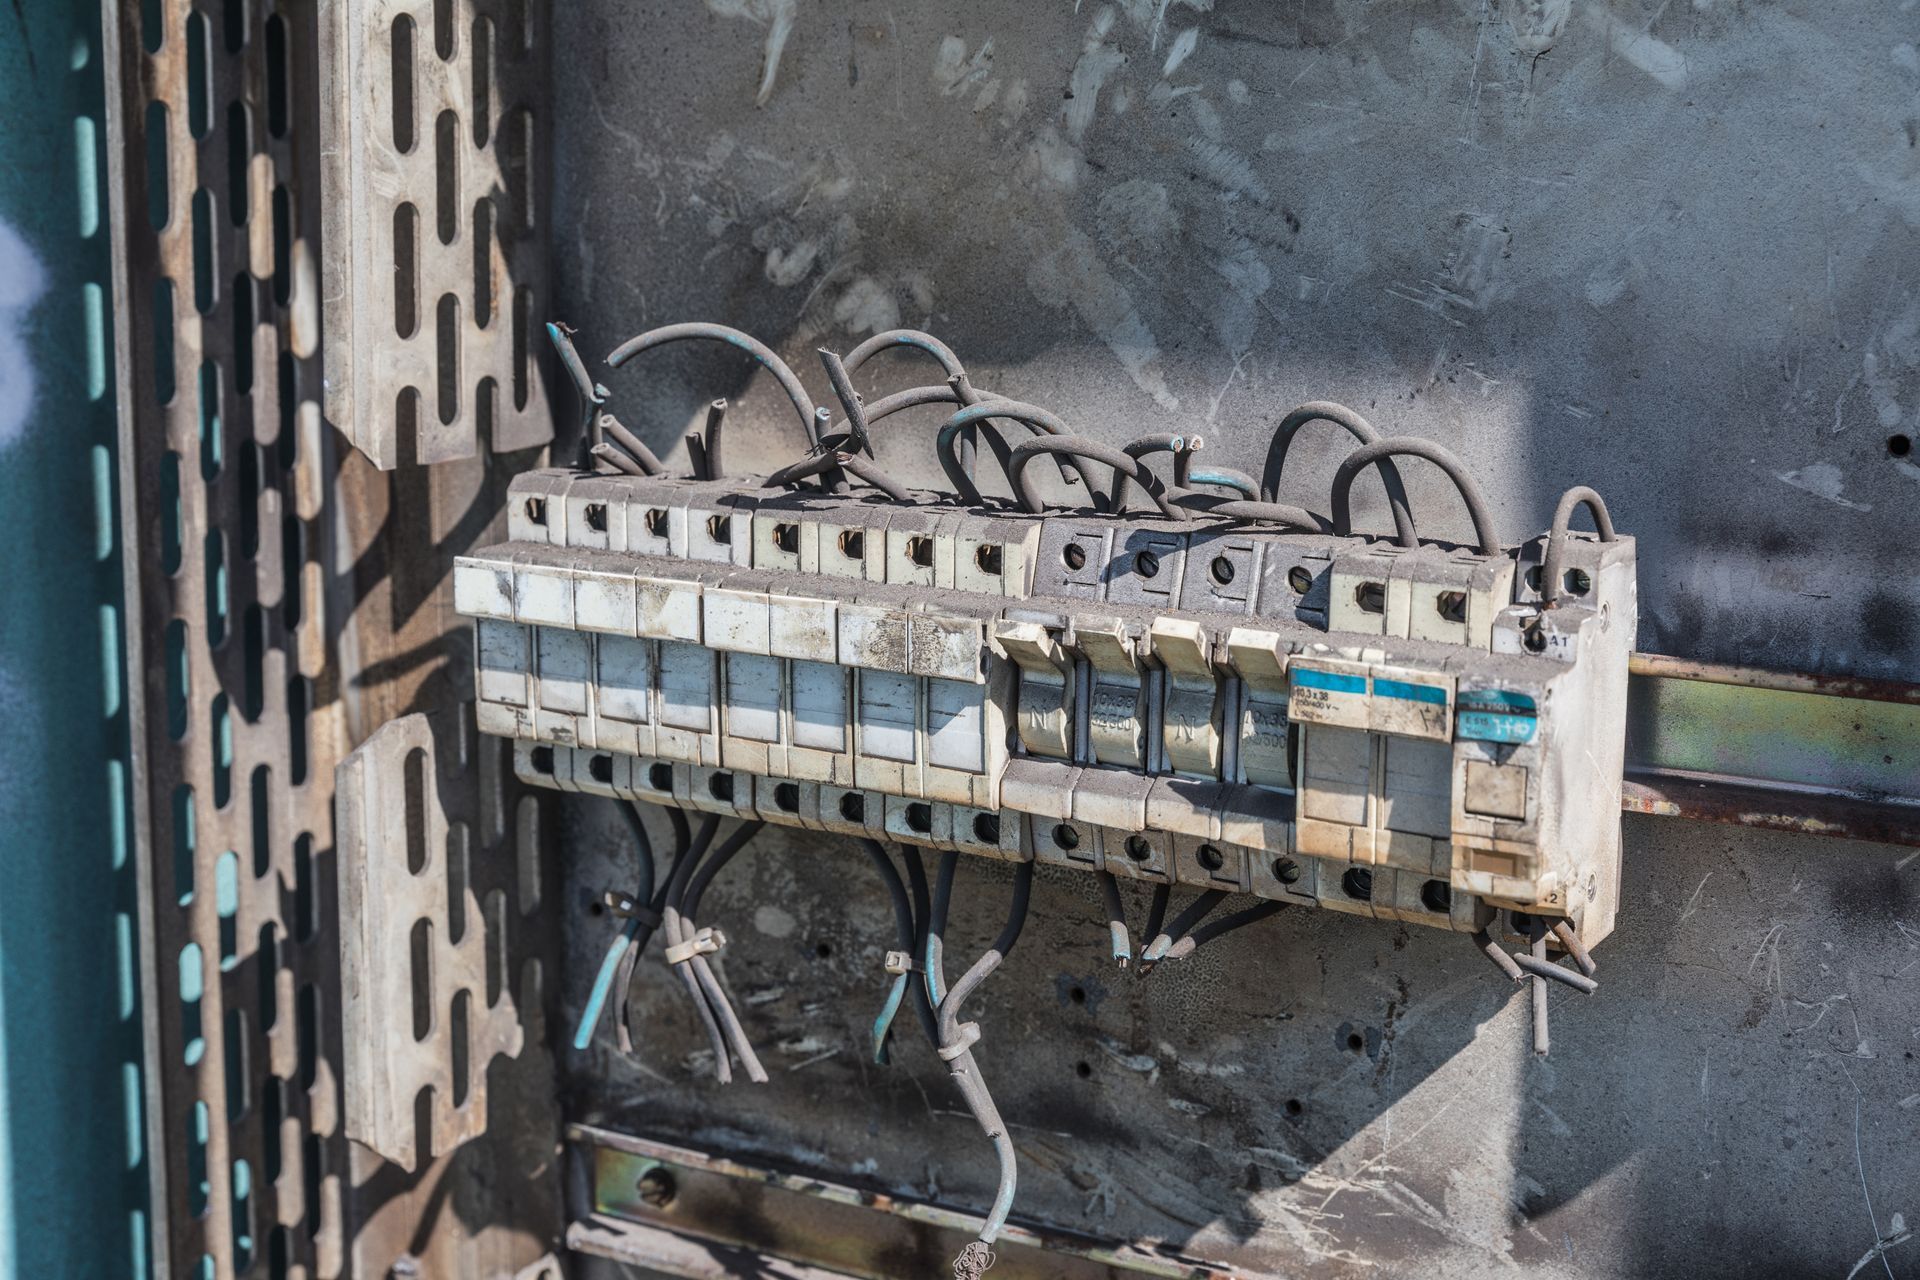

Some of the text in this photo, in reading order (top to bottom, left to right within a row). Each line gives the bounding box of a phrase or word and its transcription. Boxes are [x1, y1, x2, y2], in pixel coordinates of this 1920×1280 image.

[1549, 634, 1568, 648] A1
[1030, 704, 1048, 731] N
[1176, 714, 1195, 743] N
